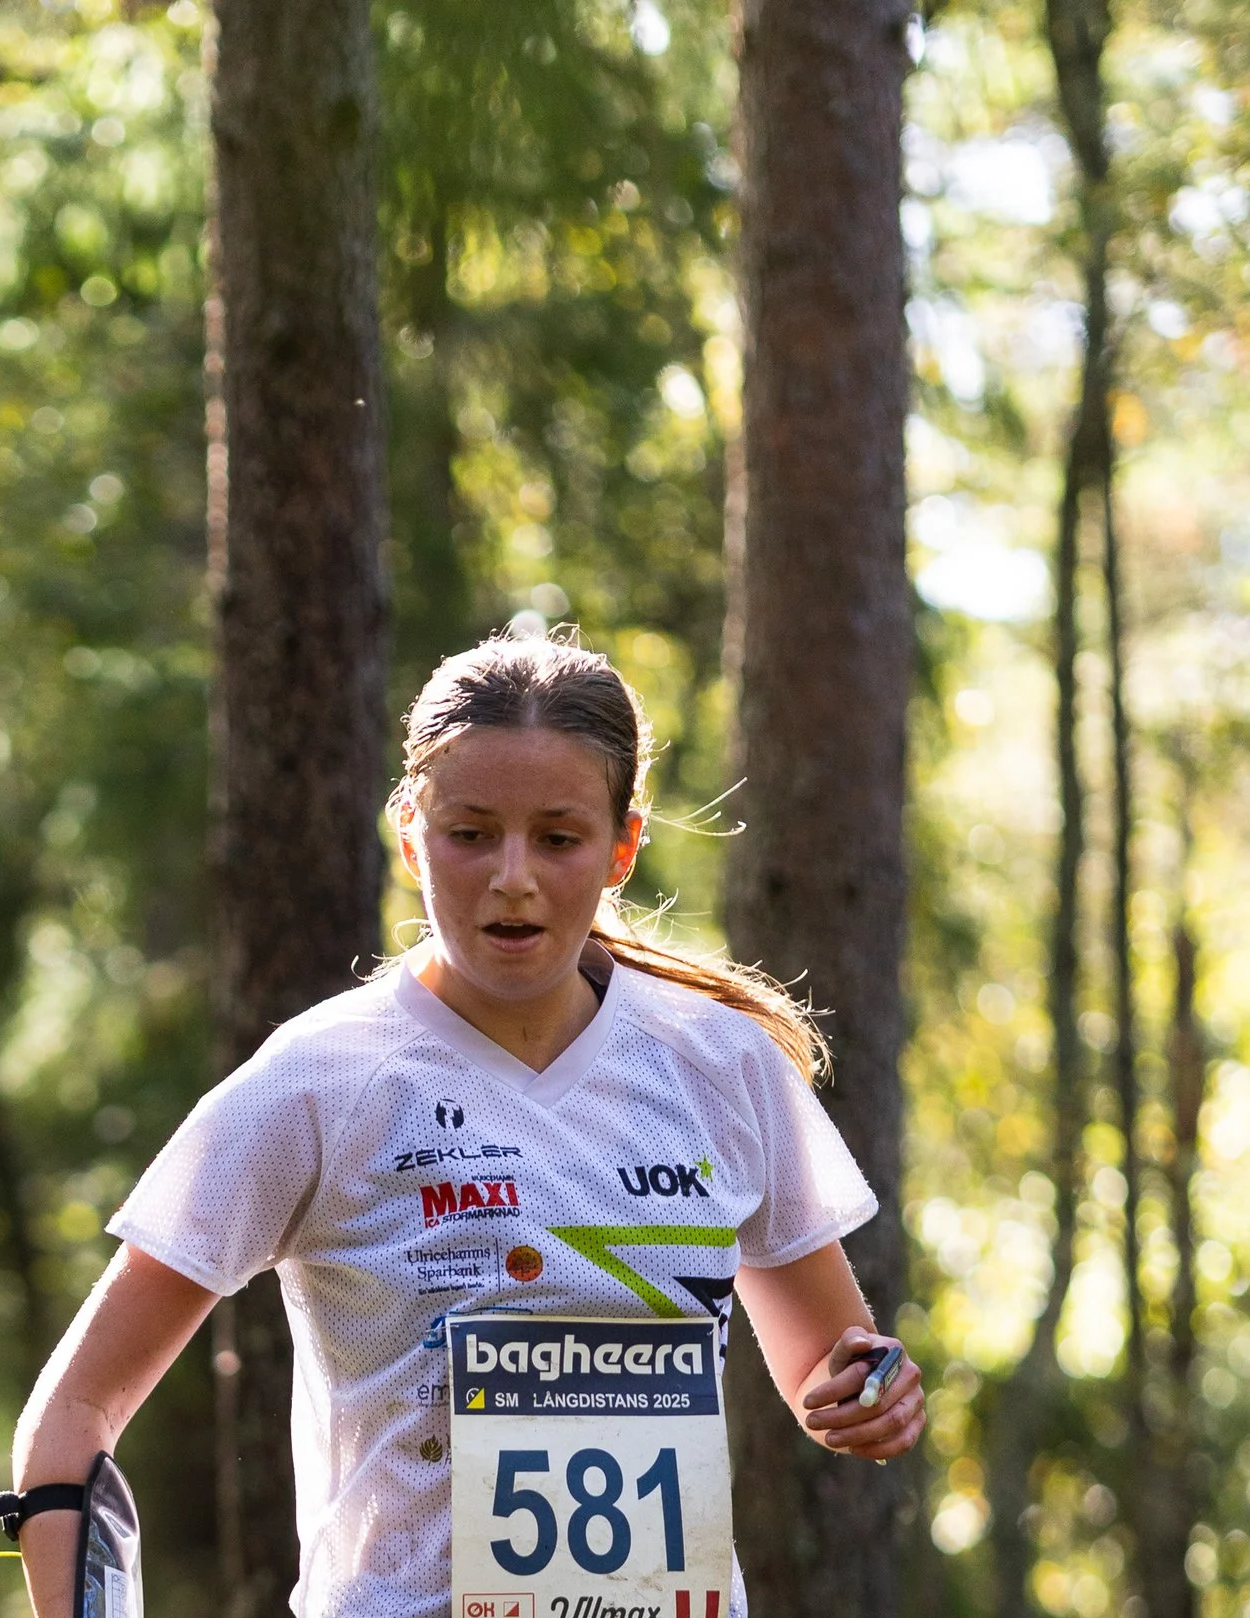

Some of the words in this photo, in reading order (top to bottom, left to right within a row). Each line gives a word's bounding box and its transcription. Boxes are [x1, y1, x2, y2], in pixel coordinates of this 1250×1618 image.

[394, 1145, 523, 1172] ZEKLER
[616, 1164, 710, 1198] UOK
[420, 1181, 519, 1218] MAXI
[425, 1218, 440, 1228] ICA
[442, 1207, 520, 1223] STORMARKNAD
[407, 1247, 491, 1263] Ulricehamns
[417, 1264, 482, 1281] Sparbank
[466, 1334, 703, 1381] bagheera
[495, 1392, 519, 1408] SM
[533, 1390, 649, 1408] LÅNGDISTANS
[653, 1393, 691, 1409] 2025
[490, 1447, 686, 1576] 581
